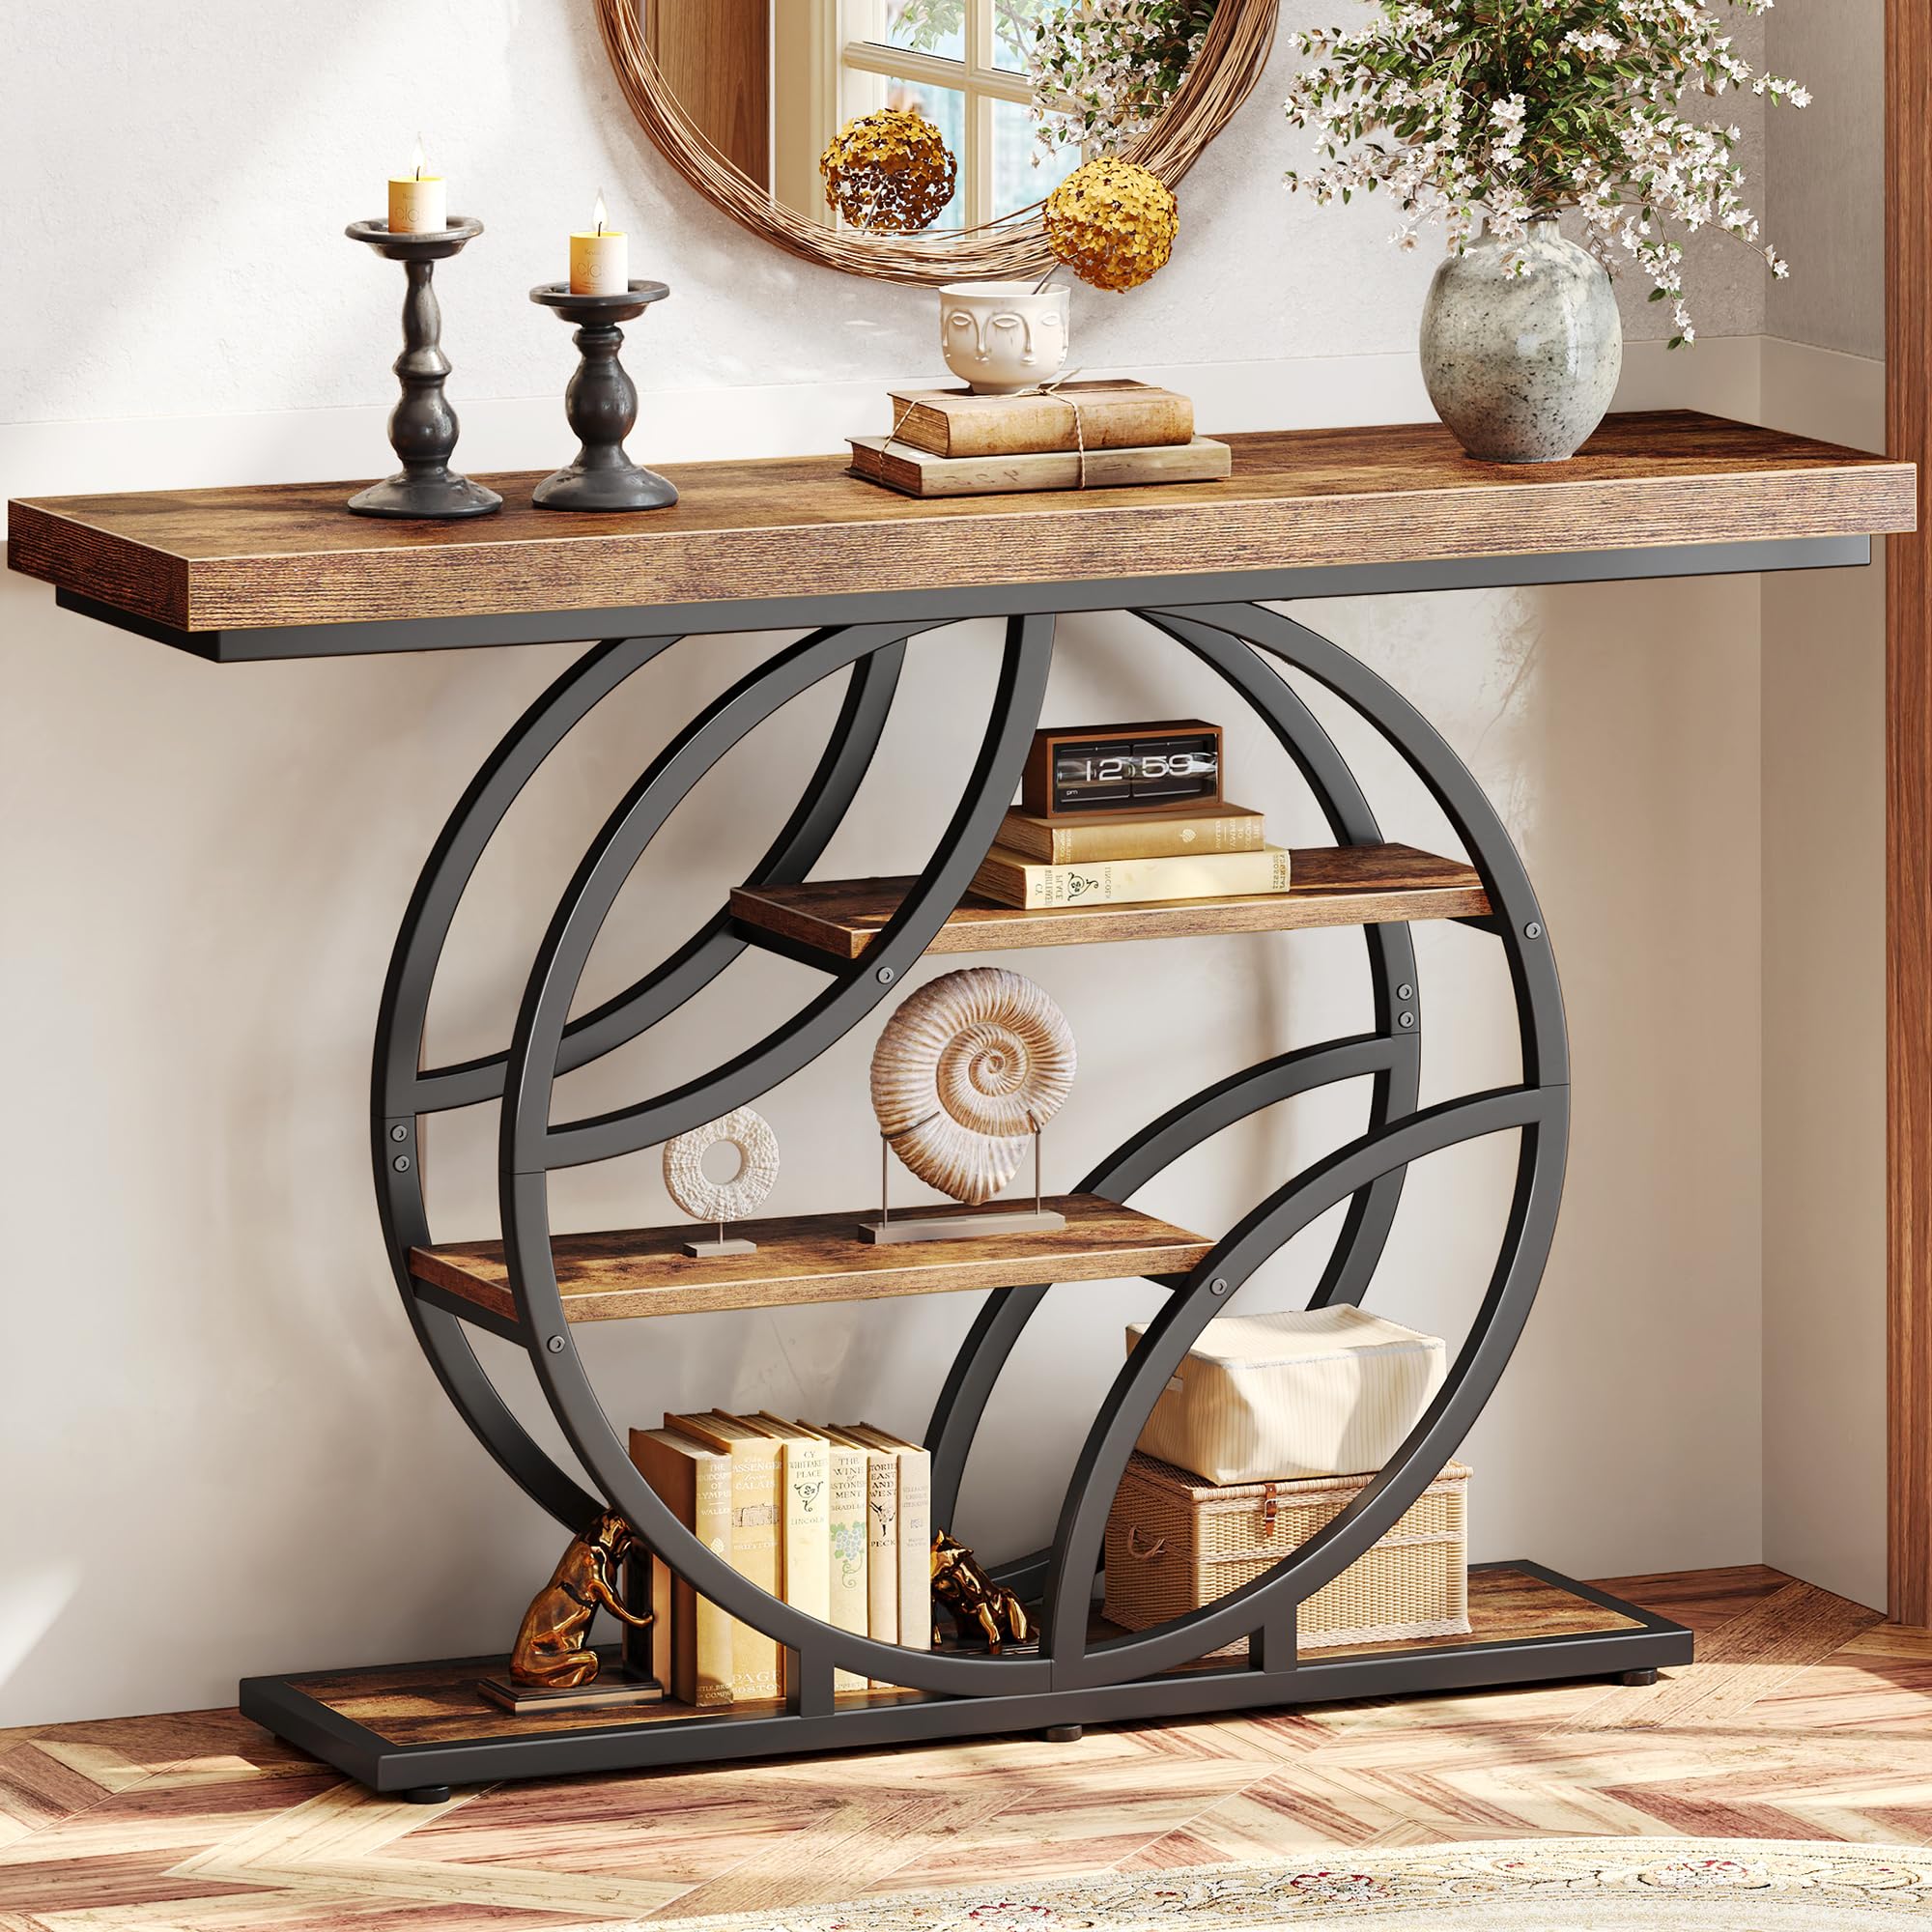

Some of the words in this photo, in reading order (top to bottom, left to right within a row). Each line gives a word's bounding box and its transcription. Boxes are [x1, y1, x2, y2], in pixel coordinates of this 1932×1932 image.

[1086, 758, 1124, 781] 12
[1141, 754, 1194, 779] 59
[732, 1462, 782, 1473] ASSENGER
[833, 1466, 865, 1476] WINE
[796, 1469, 821, 1479] PLACE
[870, 1471, 896, 1481] EAST
[871, 1481, 895, 1490] AND
[835, 1491, 863, 1499] MENT
[869, 1490, 896, 1498] WEST
[870, 1539, 896, 1548] PECK
[732, 1670, 781, 1684] PAGE
